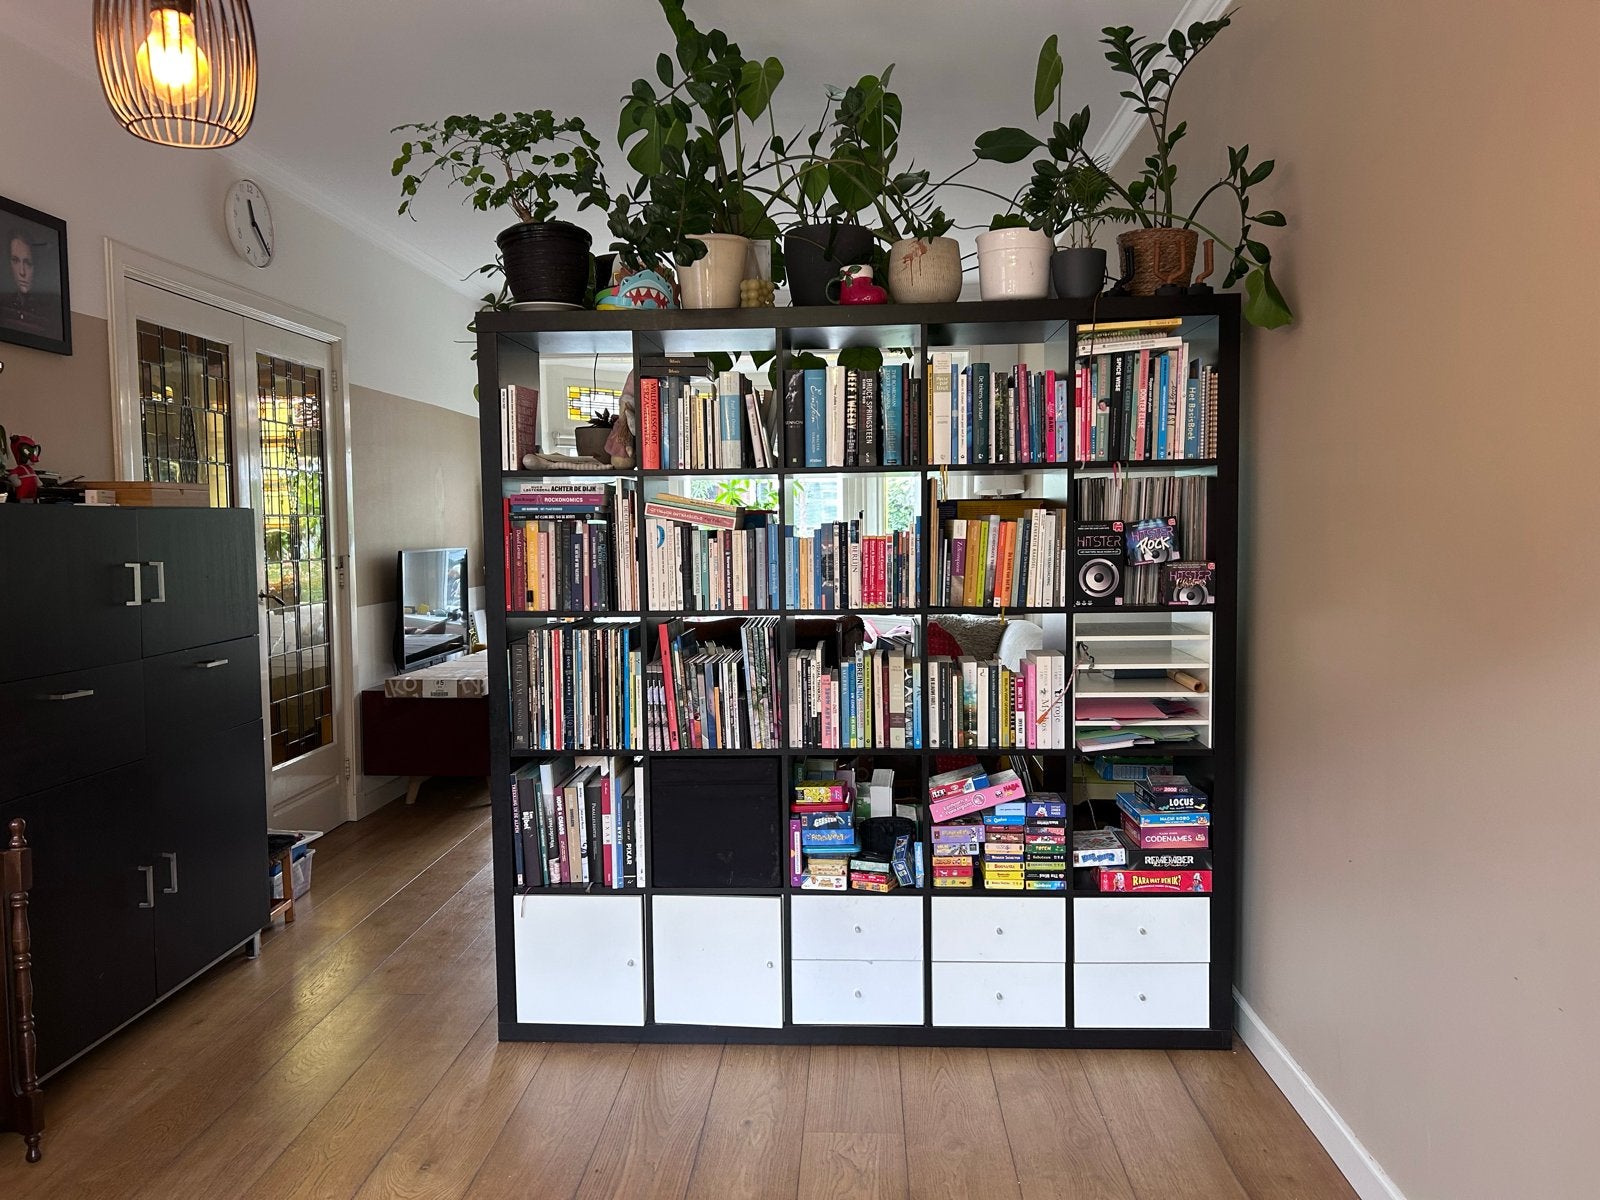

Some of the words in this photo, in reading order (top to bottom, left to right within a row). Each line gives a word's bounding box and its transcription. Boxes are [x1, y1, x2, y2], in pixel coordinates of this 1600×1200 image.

[846, 372, 858, 393] JEFF
[650, 383, 658, 411] WILLEM
[1188, 387, 1196, 400] Het
[846, 394, 858, 430] TWEEDY
[1187, 402, 1196, 440] BasisBoek
[1077, 536, 1122, 547] HITSTER
[1136, 536, 1170, 556] ROCK
[1170, 570, 1212, 582] HITSTER
[515, 648, 523, 676] PEARL
[514, 679, 523, 696] JAM
[1004, 783, 1020, 792] HABA
[1169, 798, 1194, 806] LOCUS
[1144, 835, 1192, 843] CODENAMES
[1144, 856, 1194, 865] REMEMBER
